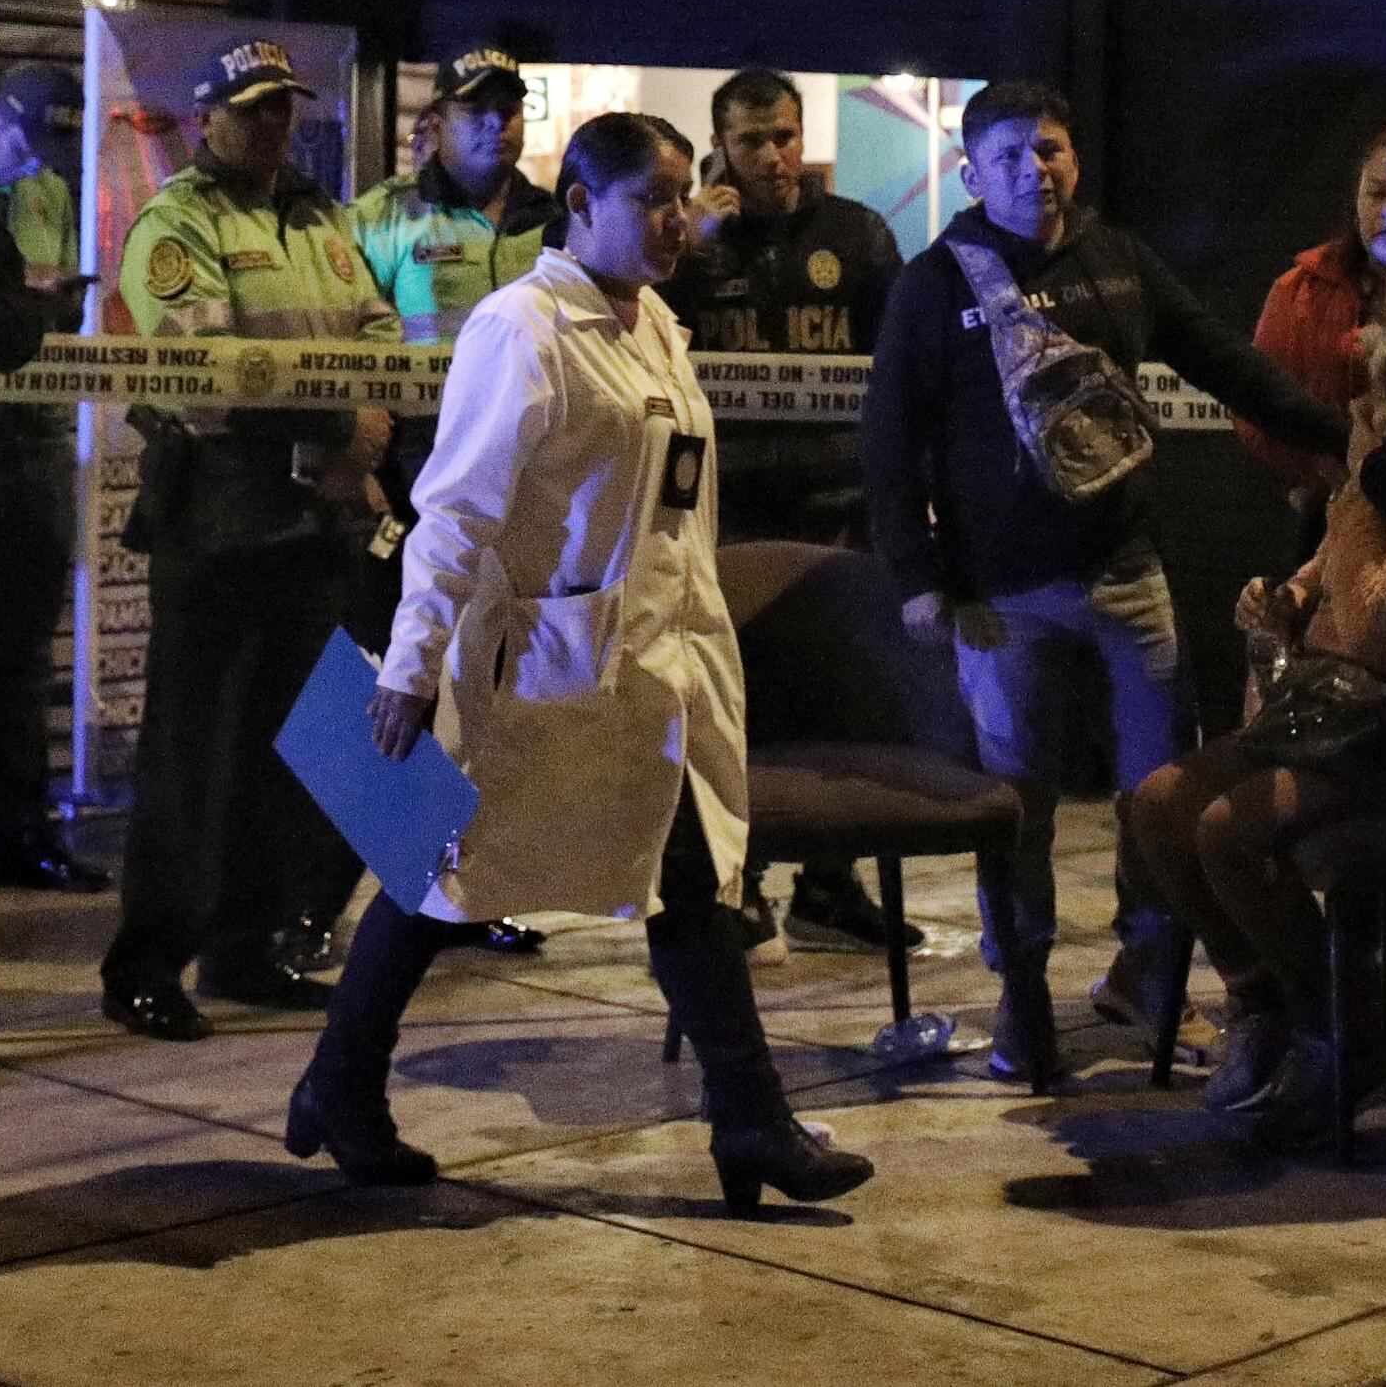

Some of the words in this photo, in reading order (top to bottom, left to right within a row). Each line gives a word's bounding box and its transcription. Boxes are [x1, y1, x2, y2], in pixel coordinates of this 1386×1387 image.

[220, 39, 293, 81] POLICIA
[381, 355, 411, 372] NO
[778, 367, 803, 383] NO
[362, 381, 401, 399] DEL
[758, 391, 794, 409] DEL
